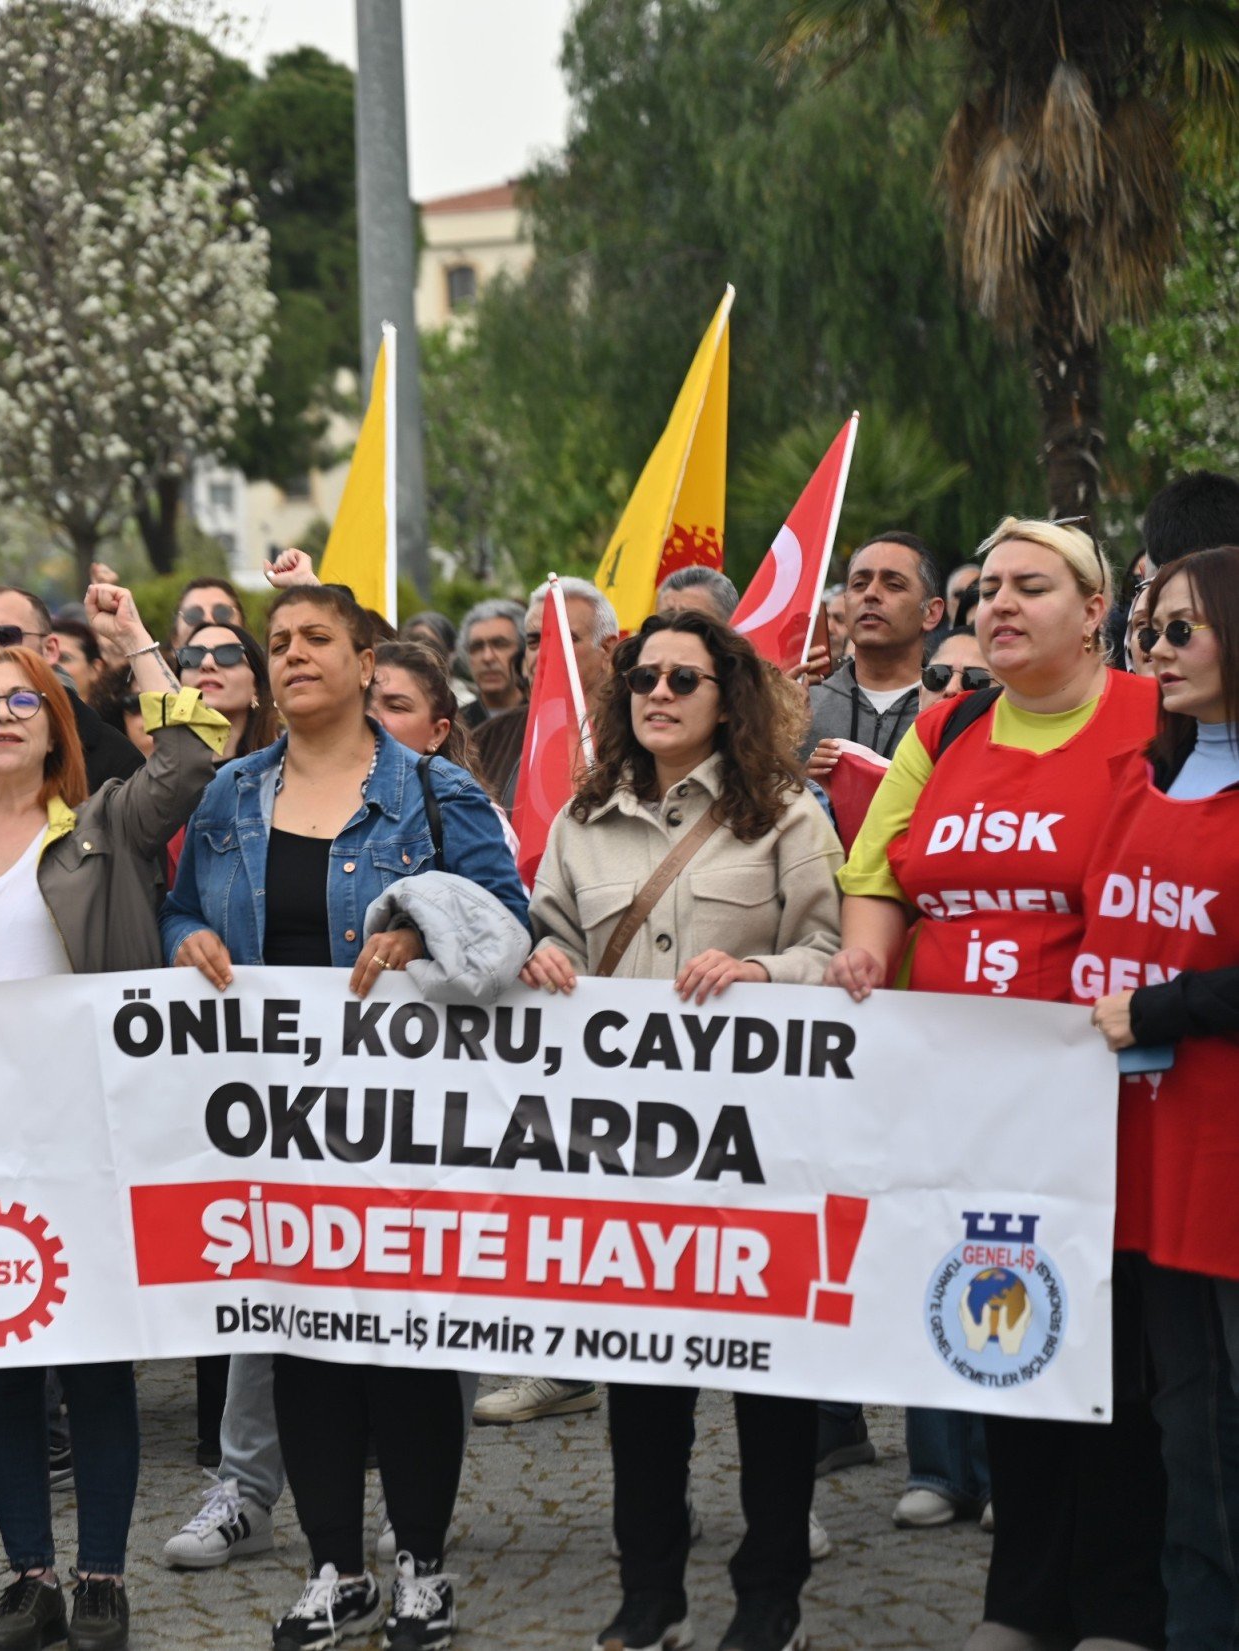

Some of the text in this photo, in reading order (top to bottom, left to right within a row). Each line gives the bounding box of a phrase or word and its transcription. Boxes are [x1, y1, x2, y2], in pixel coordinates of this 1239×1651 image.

[925, 802, 1065, 856] DİSK
[1098, 866, 1220, 936] DİSK
[964, 929, 1019, 994] İŞ
[112, 988, 857, 1079] ÖNLE, KORU, CAYDIR
[204, 1081, 767, 1184] OKULLARDA
[200, 1185, 506, 1277] ŞİDDETE
[963, 1243, 1036, 1273] GENEL-İŞ
[215, 1298, 771, 1372] DİSK/GENEL-İŞ İZMİR 7 NOLU ŞUBE
[950, 1356, 1020, 1388] HİZMETLER
